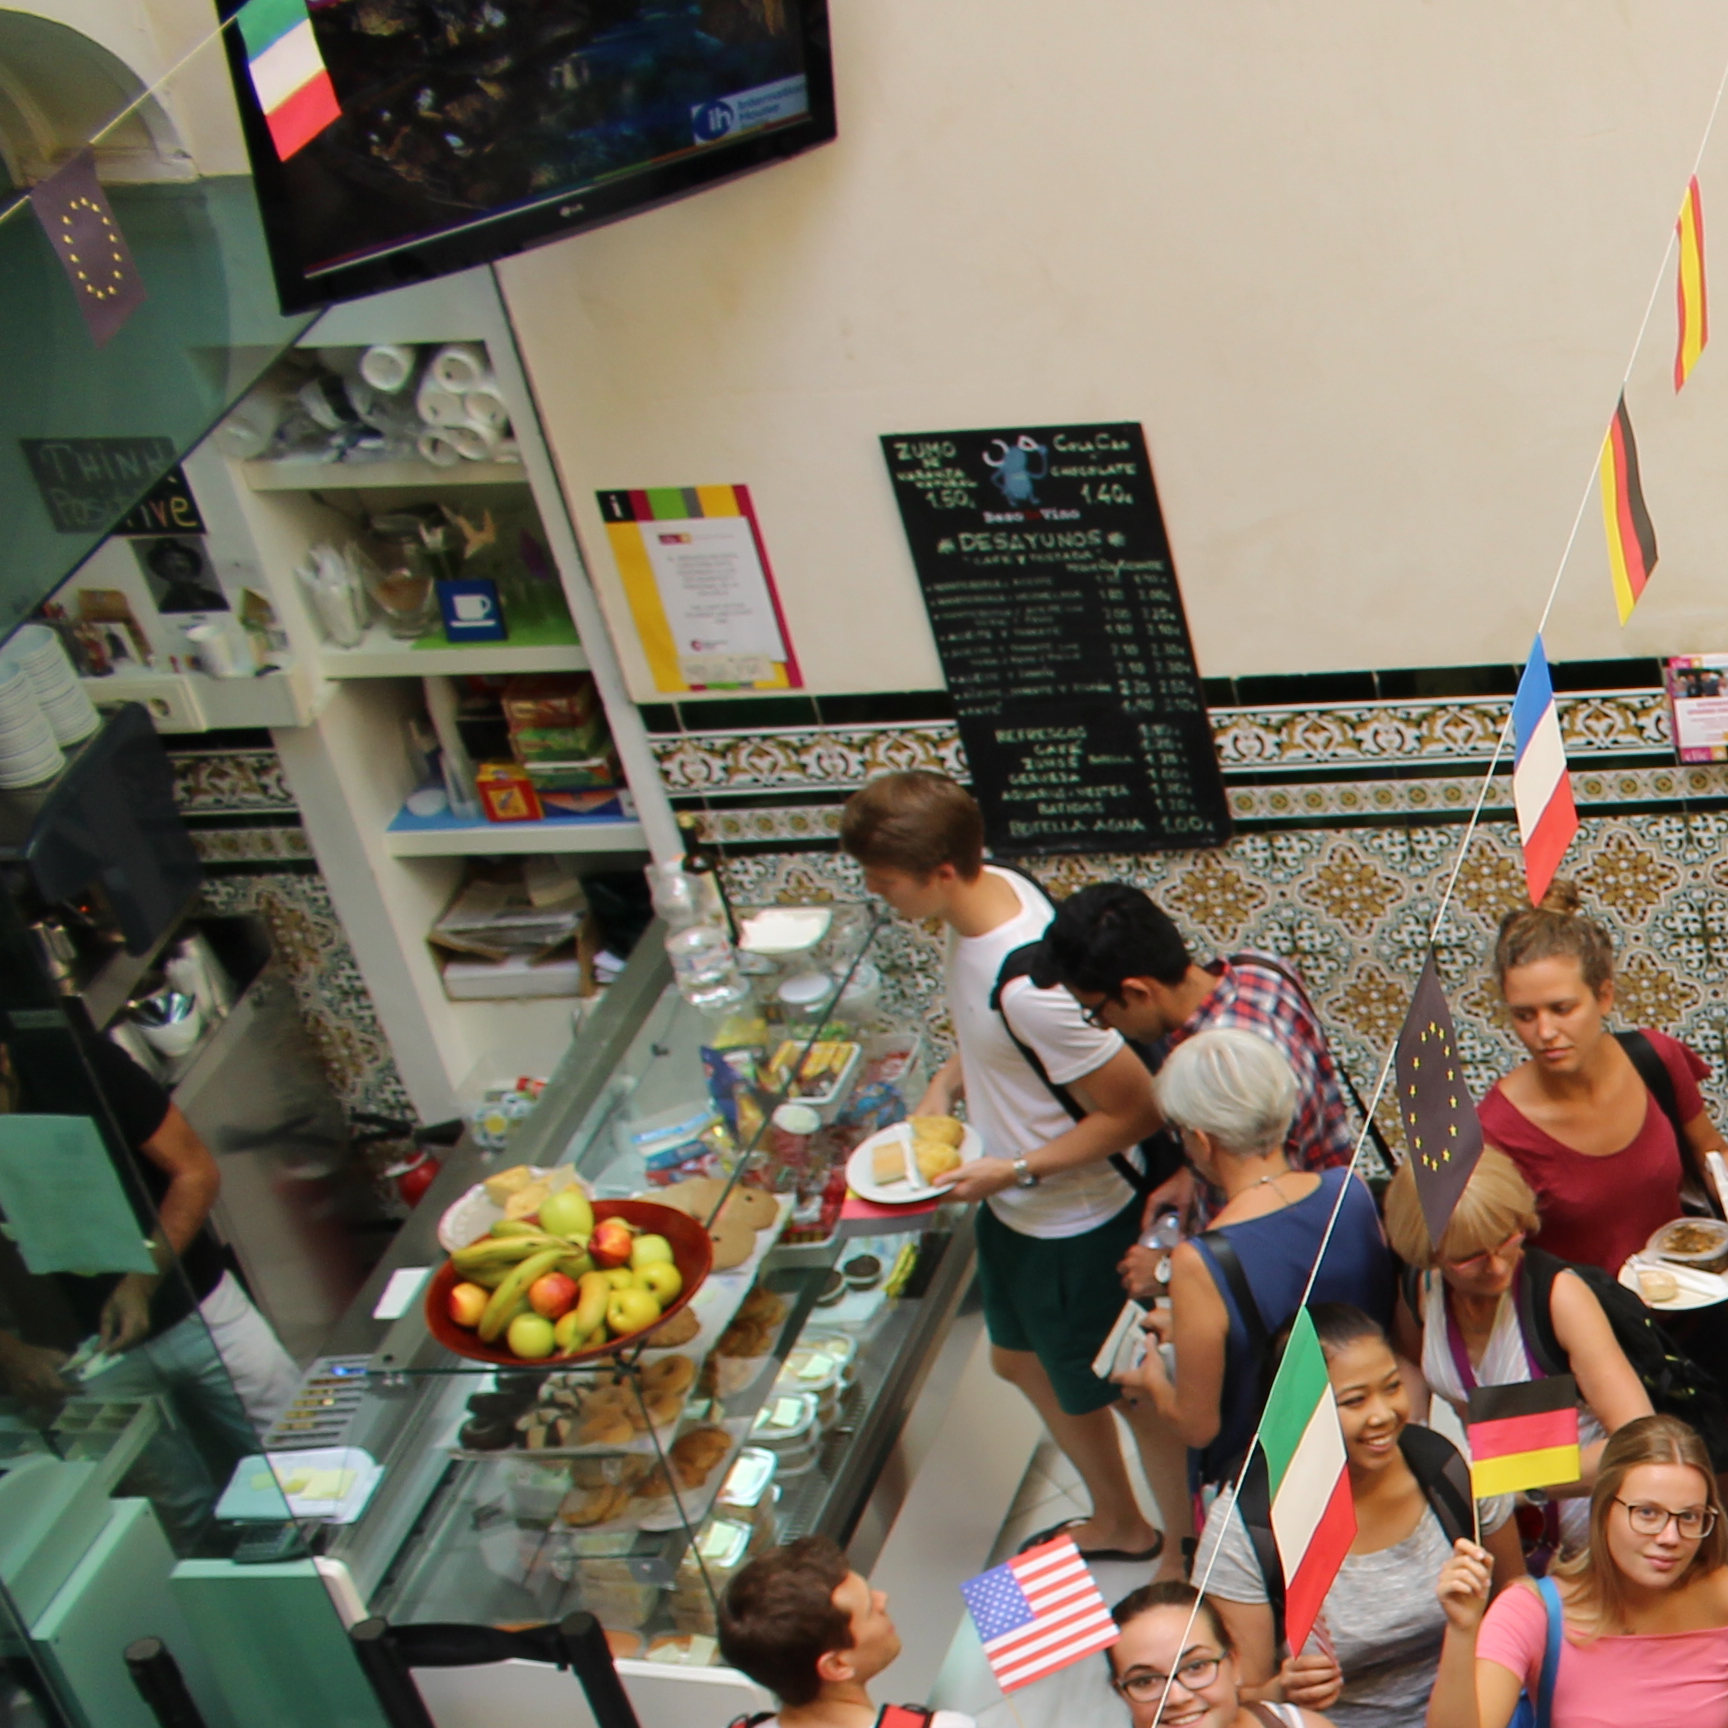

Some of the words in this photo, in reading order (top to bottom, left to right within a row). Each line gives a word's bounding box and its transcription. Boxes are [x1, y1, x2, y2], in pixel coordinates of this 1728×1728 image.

[958, 529, 1103, 552] DESAYUNOS
[995, 726, 1087, 743] REFRESCOS
[1009, 819, 1087, 836] BOTELLA
[1093, 819, 1147, 832] AGUA
